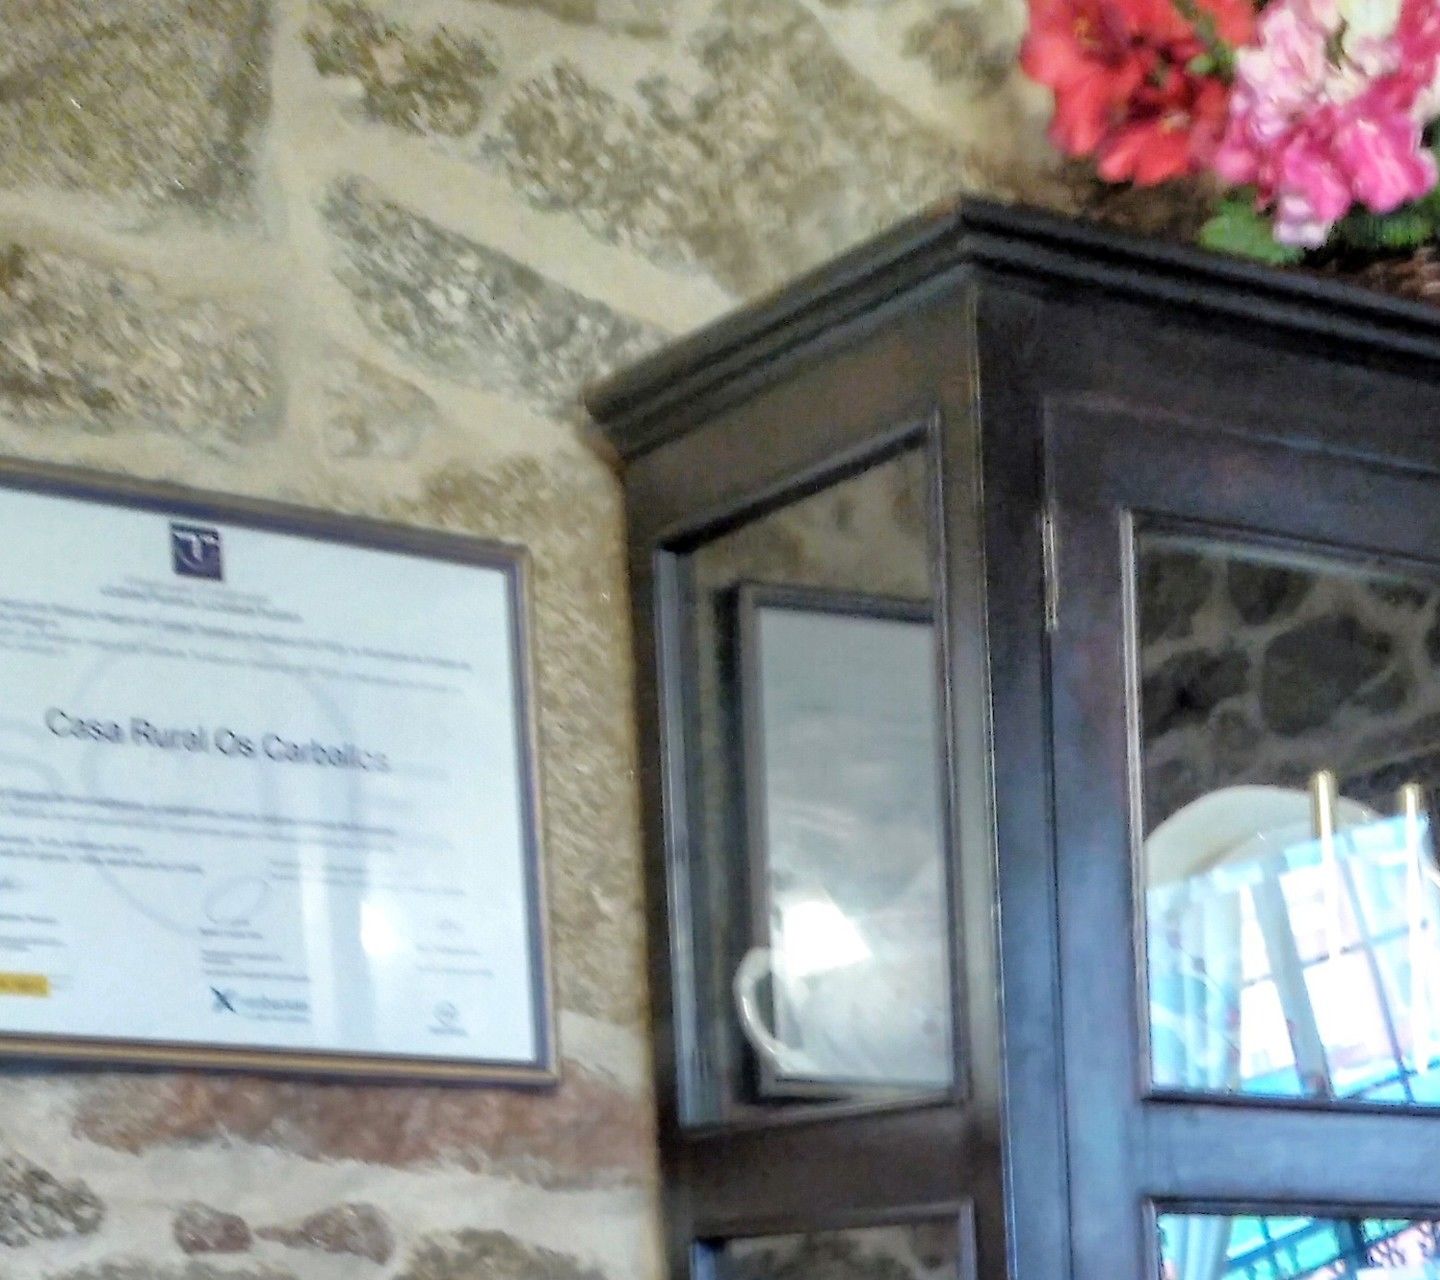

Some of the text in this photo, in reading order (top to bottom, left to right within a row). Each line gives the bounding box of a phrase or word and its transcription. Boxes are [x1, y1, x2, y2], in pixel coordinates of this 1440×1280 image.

[45, 707, 126, 744] Casa
[130, 716, 209, 752] Rural
[214, 727, 257, 759] Os
